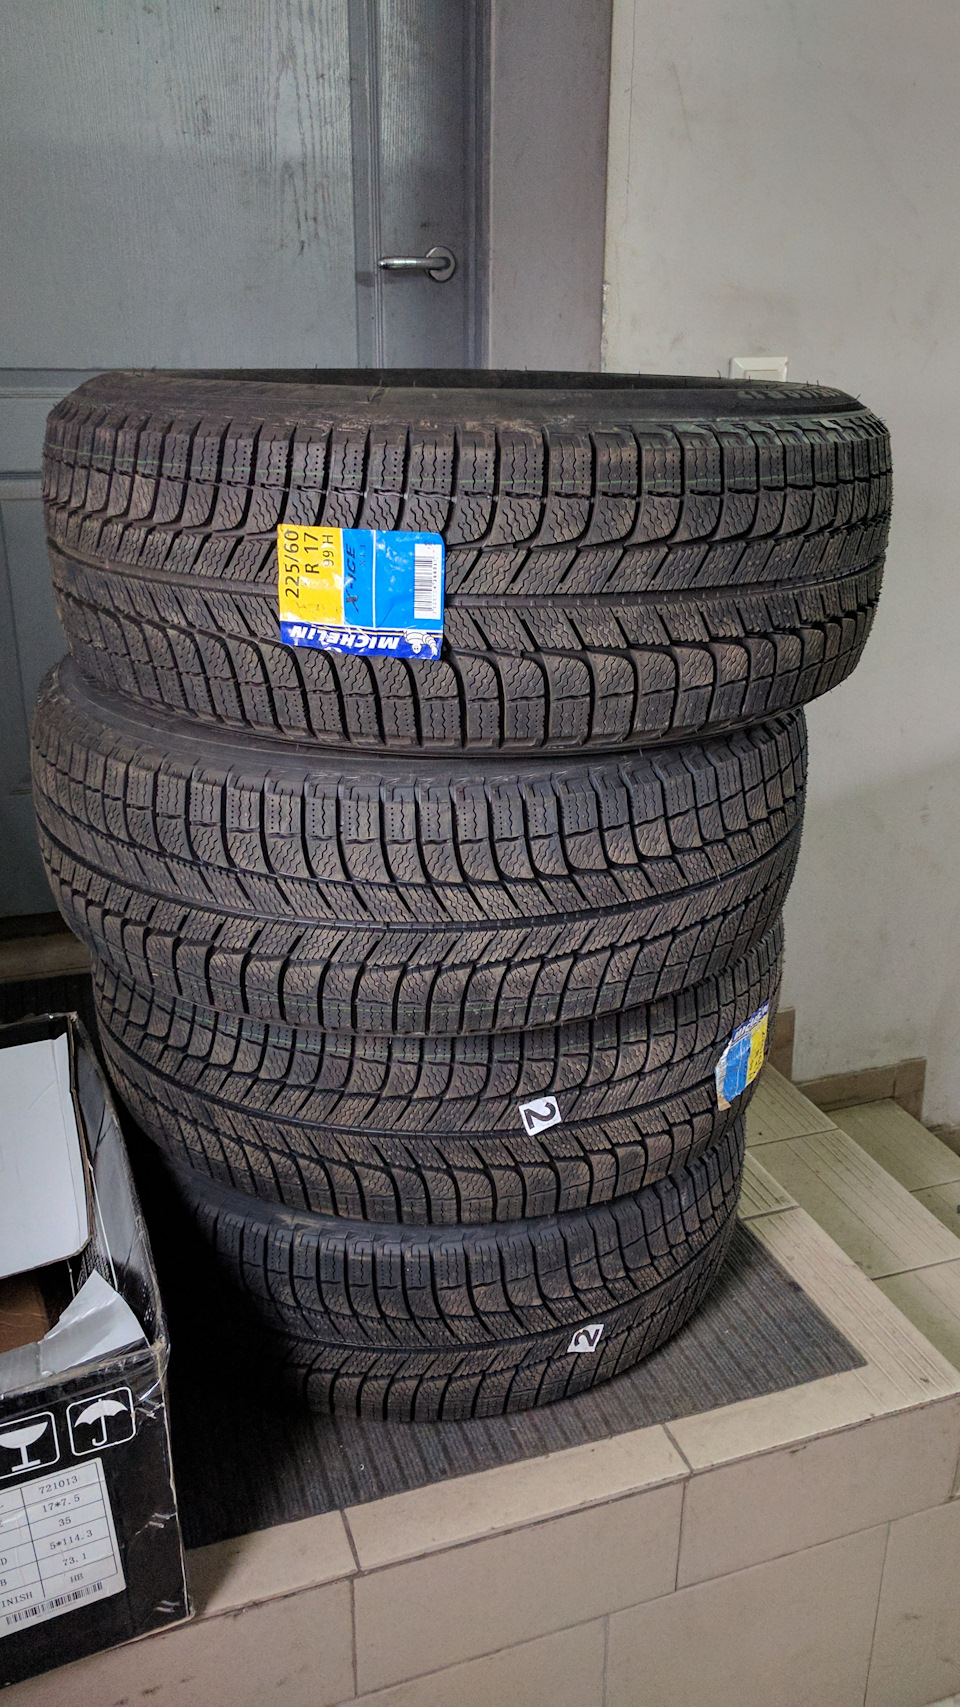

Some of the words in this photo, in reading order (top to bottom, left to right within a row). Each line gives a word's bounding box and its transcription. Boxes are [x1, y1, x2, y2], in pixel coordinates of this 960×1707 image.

[303, 532, 319, 554] 17
[283, 529, 300, 599] 225/60
[304, 563, 320, 574] R
[345, 543, 359, 613] X-ICE
[289, 625, 400, 650] MICHELIN
[523, 1101, 557, 1130] 2
[573, 1328, 600, 1349] 2
[39, 1475, 79, 1495] 721013
[58, 1516, 72, 1527] 35
[62, 1552, 88, 1567] 73.1
